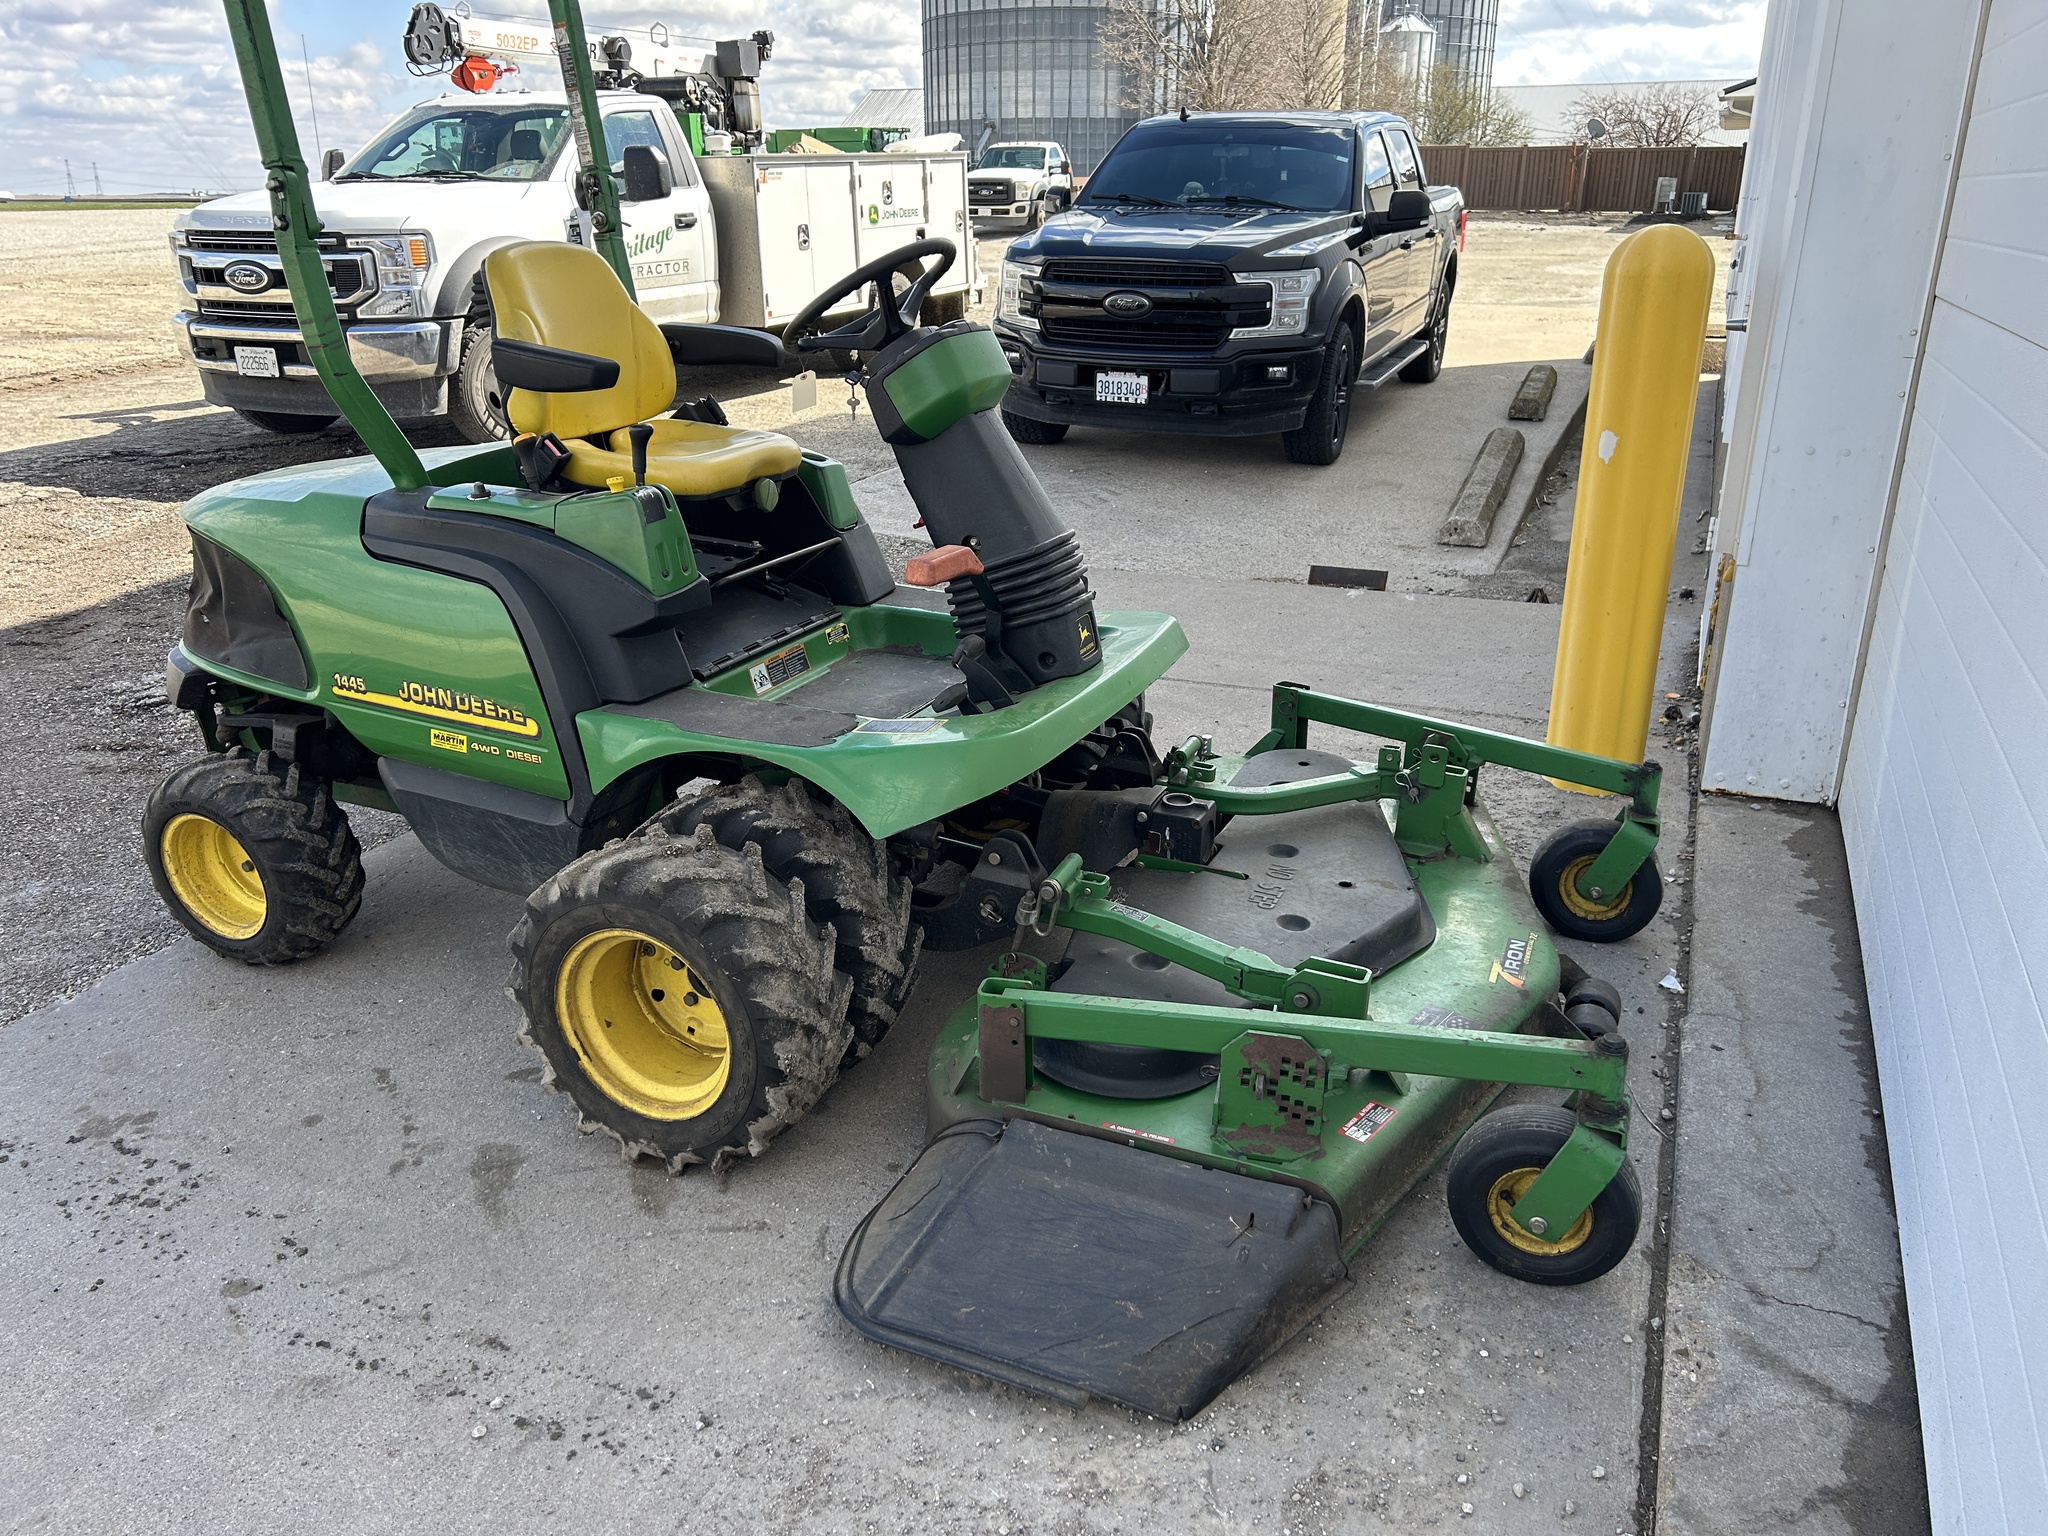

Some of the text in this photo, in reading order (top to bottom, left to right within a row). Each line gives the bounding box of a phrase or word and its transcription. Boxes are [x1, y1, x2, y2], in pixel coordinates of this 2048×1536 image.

[496, 33, 539, 51] 5032EP
[881, 207, 919, 220] JOHN DEERE
[626, 225, 674, 259] ritage
[234, 269, 257, 284] Ford
[1115, 298, 1139, 310] Ford
[240, 355, 269, 371] 222566
[1097, 379, 1141, 397] 3818348
[333, 673, 366, 691] 1445
[398, 681, 525, 723] JOHN DEERE
[433, 733, 465, 746] MARTIN
[470, 742, 500, 755] 4WD
[1248, 863, 1299, 910] NO STEP
[1488, 939, 1526, 988] 7 IRON
[1116, 1125, 1137, 1134] DANGER
